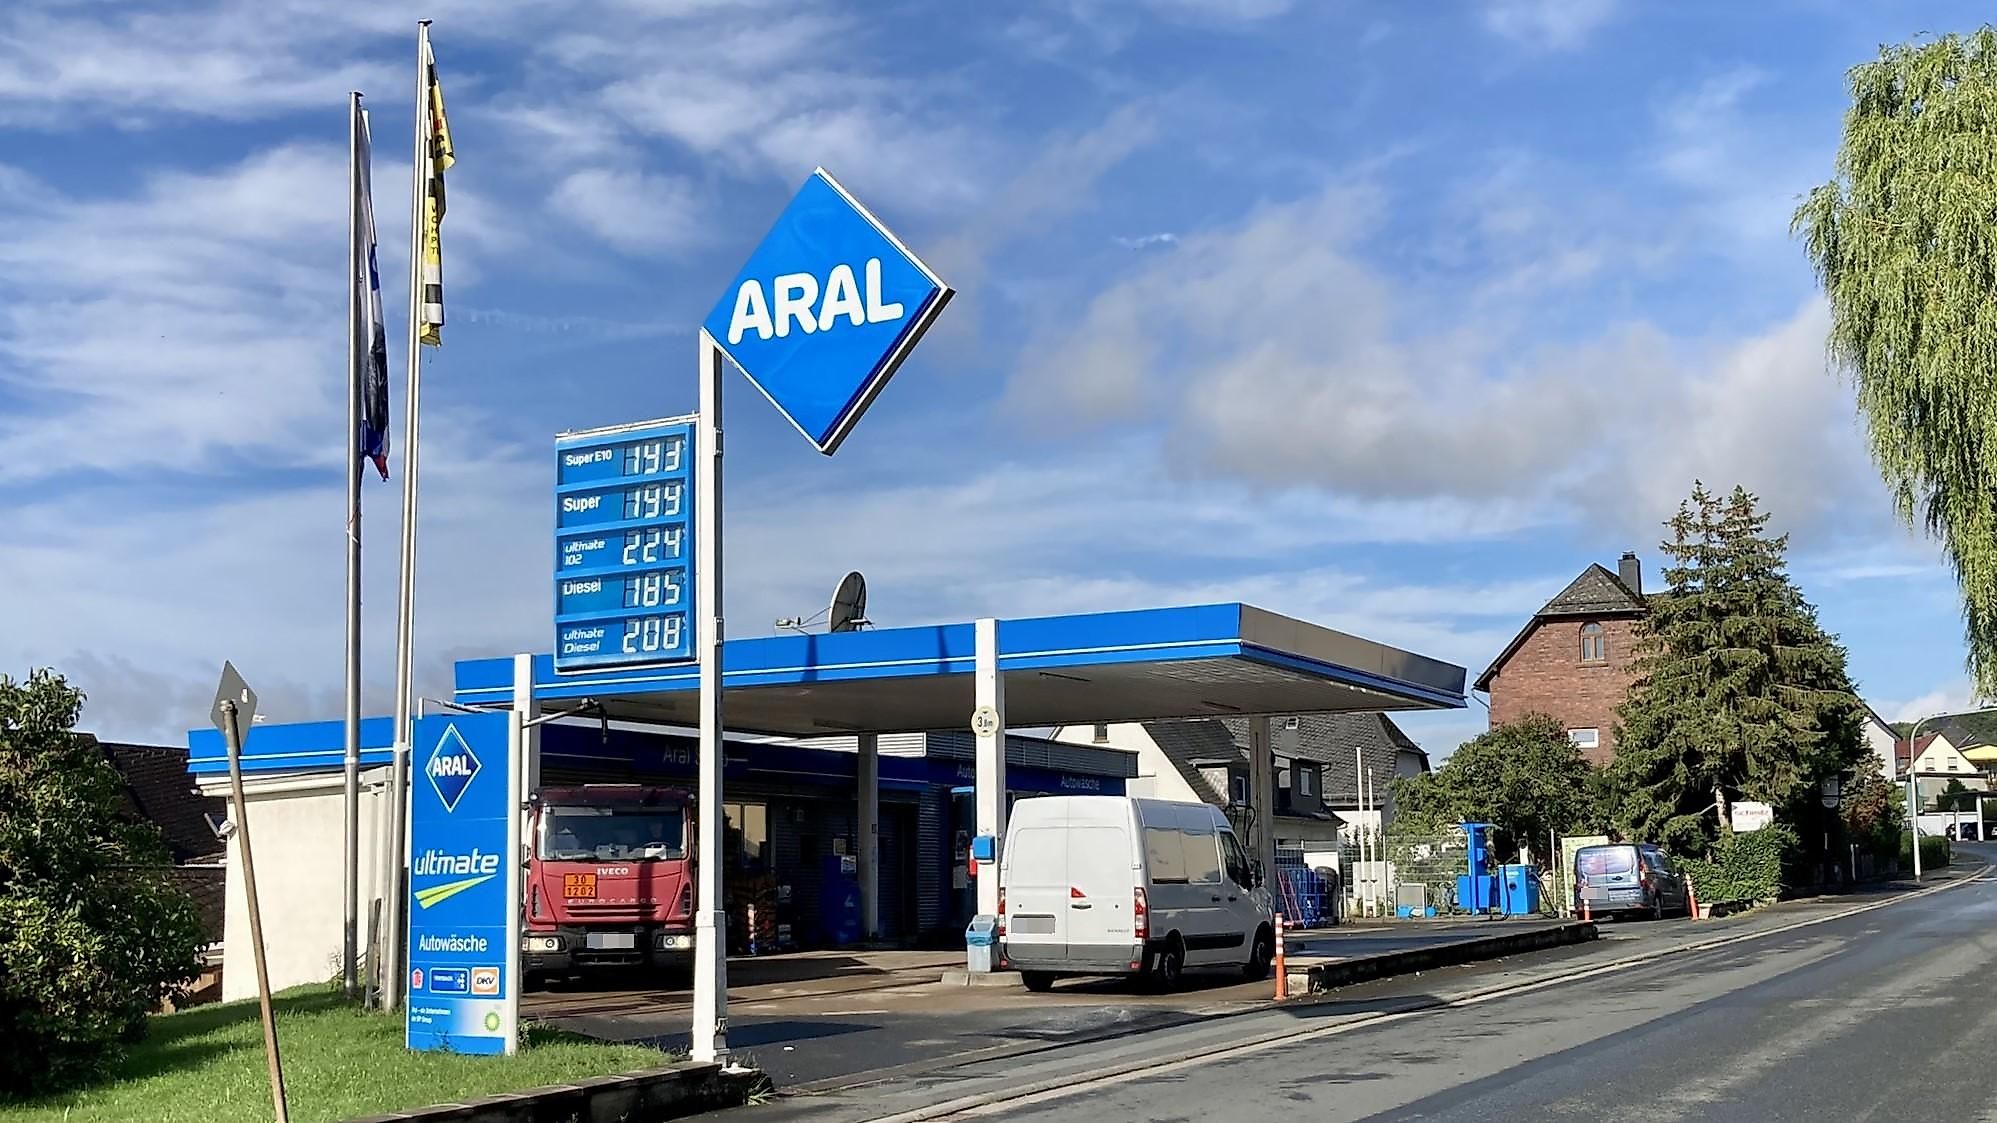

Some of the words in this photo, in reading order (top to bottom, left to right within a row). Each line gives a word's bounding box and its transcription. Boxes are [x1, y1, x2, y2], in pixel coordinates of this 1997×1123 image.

[727, 257, 904, 345] ARAL
[566, 453, 594, 466] Super
[595, 450, 612, 462] E10
[632, 441, 680, 475] 193
[563, 496, 601, 512] Super
[632, 485, 680, 518] 199
[565, 539, 606, 553] ultimate
[623, 529, 680, 564] 224
[564, 553, 583, 565] 102
[563, 578, 602, 596] Diesel
[632, 573, 680, 606] 185
[563, 628, 605, 641] ultimate
[623, 616, 680, 652] 208
[563, 640, 601, 654] Diesel
[663, 744, 691, 764] Aral
[432, 755, 472, 777] ARAL
[1060, 775, 1100, 791] Autowäsche
[414, 848, 499, 876] ultimate
[574, 875, 586, 884] 30
[597, 867, 629, 875] IVECO
[567, 887, 594, 896] 1202
[418, 934, 488, 952] Autowäsche
[476, 976, 495, 985] DKV
